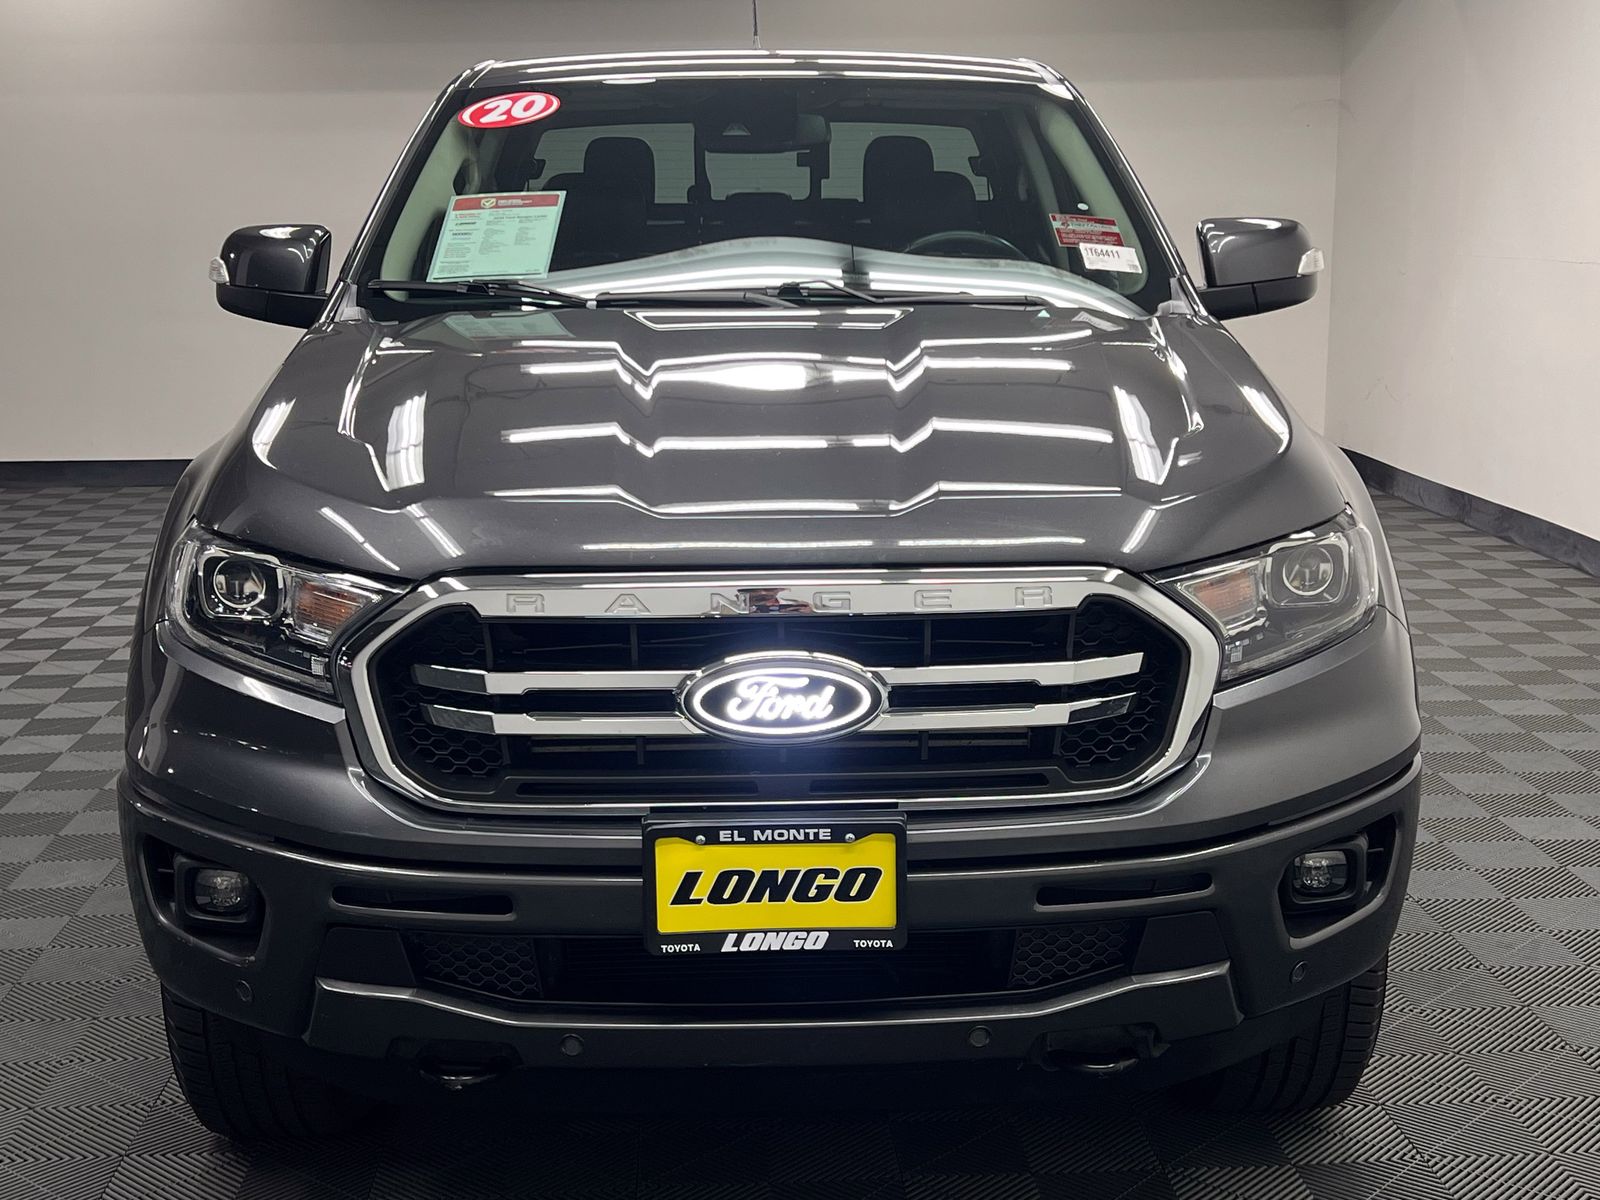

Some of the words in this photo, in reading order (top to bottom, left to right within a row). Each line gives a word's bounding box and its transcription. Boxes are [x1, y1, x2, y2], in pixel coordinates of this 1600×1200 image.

[480, 95, 547, 124] 20
[506, 586, 1053, 614] RANGER
[727, 676, 834, 720] Ford
[719, 830, 746, 842] EL
[753, 828, 832, 841] MONTE
[670, 867, 883, 906] LONGO
[660, 943, 701, 953] TOYOTA
[720, 931, 830, 953] LONGO
[853, 939, 894, 949] TOYOTA
